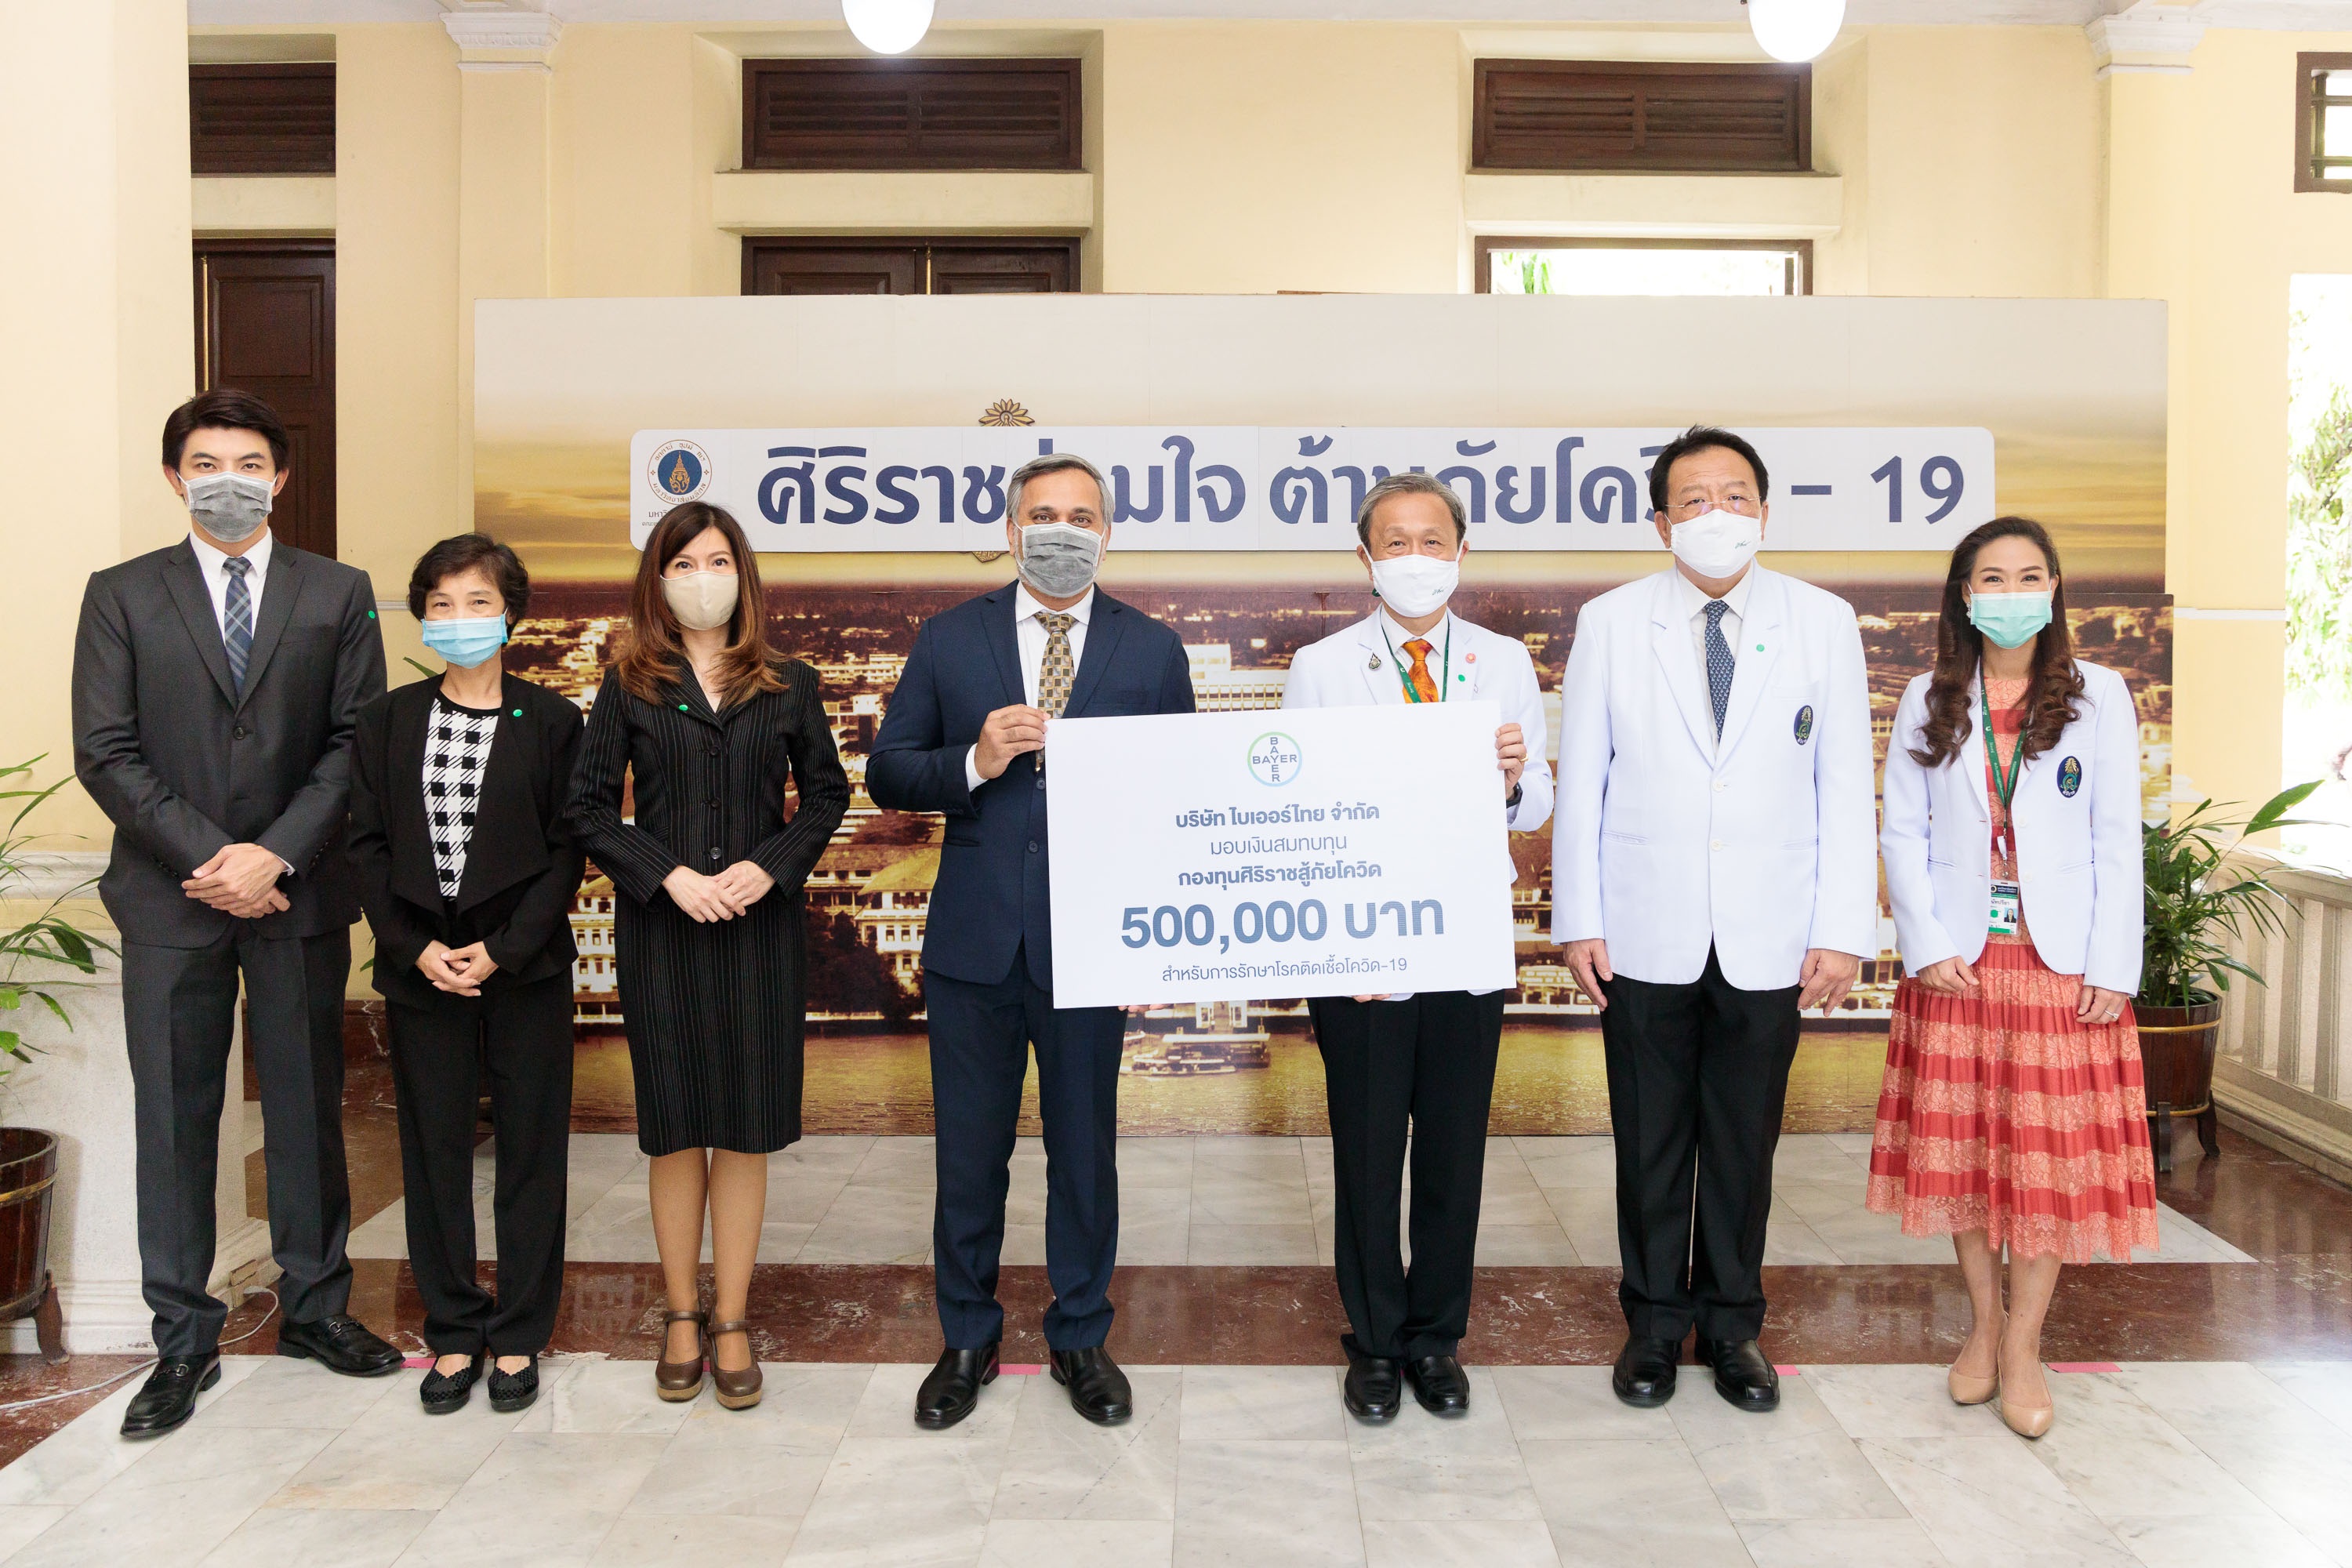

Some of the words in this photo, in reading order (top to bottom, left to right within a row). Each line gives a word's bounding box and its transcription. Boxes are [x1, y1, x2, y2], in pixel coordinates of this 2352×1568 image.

[758, 435, 1246, 524] ศิริราช่มใจ
[1871, 456, 1965, 524] 19
[1252, 754, 1298, 764] BAYER
[1270, 736, 1280, 782] BAYER
[1175, 808, 1225, 828] บริษัท
[1330, 801, 1380, 821] จำกัด
[1210, 836, 1348, 855] มอบเงินสมทบทุน
[1178, 860, 1382, 891] กองทุนศิริราชสู้ภัยโควิด
[1121, 898, 1328, 955] 500,000
[1345, 899, 1444, 939] บาท
[1162, 954, 1408, 982] สำหรับการรักษาโรคติดเชื้อโควิด-19
